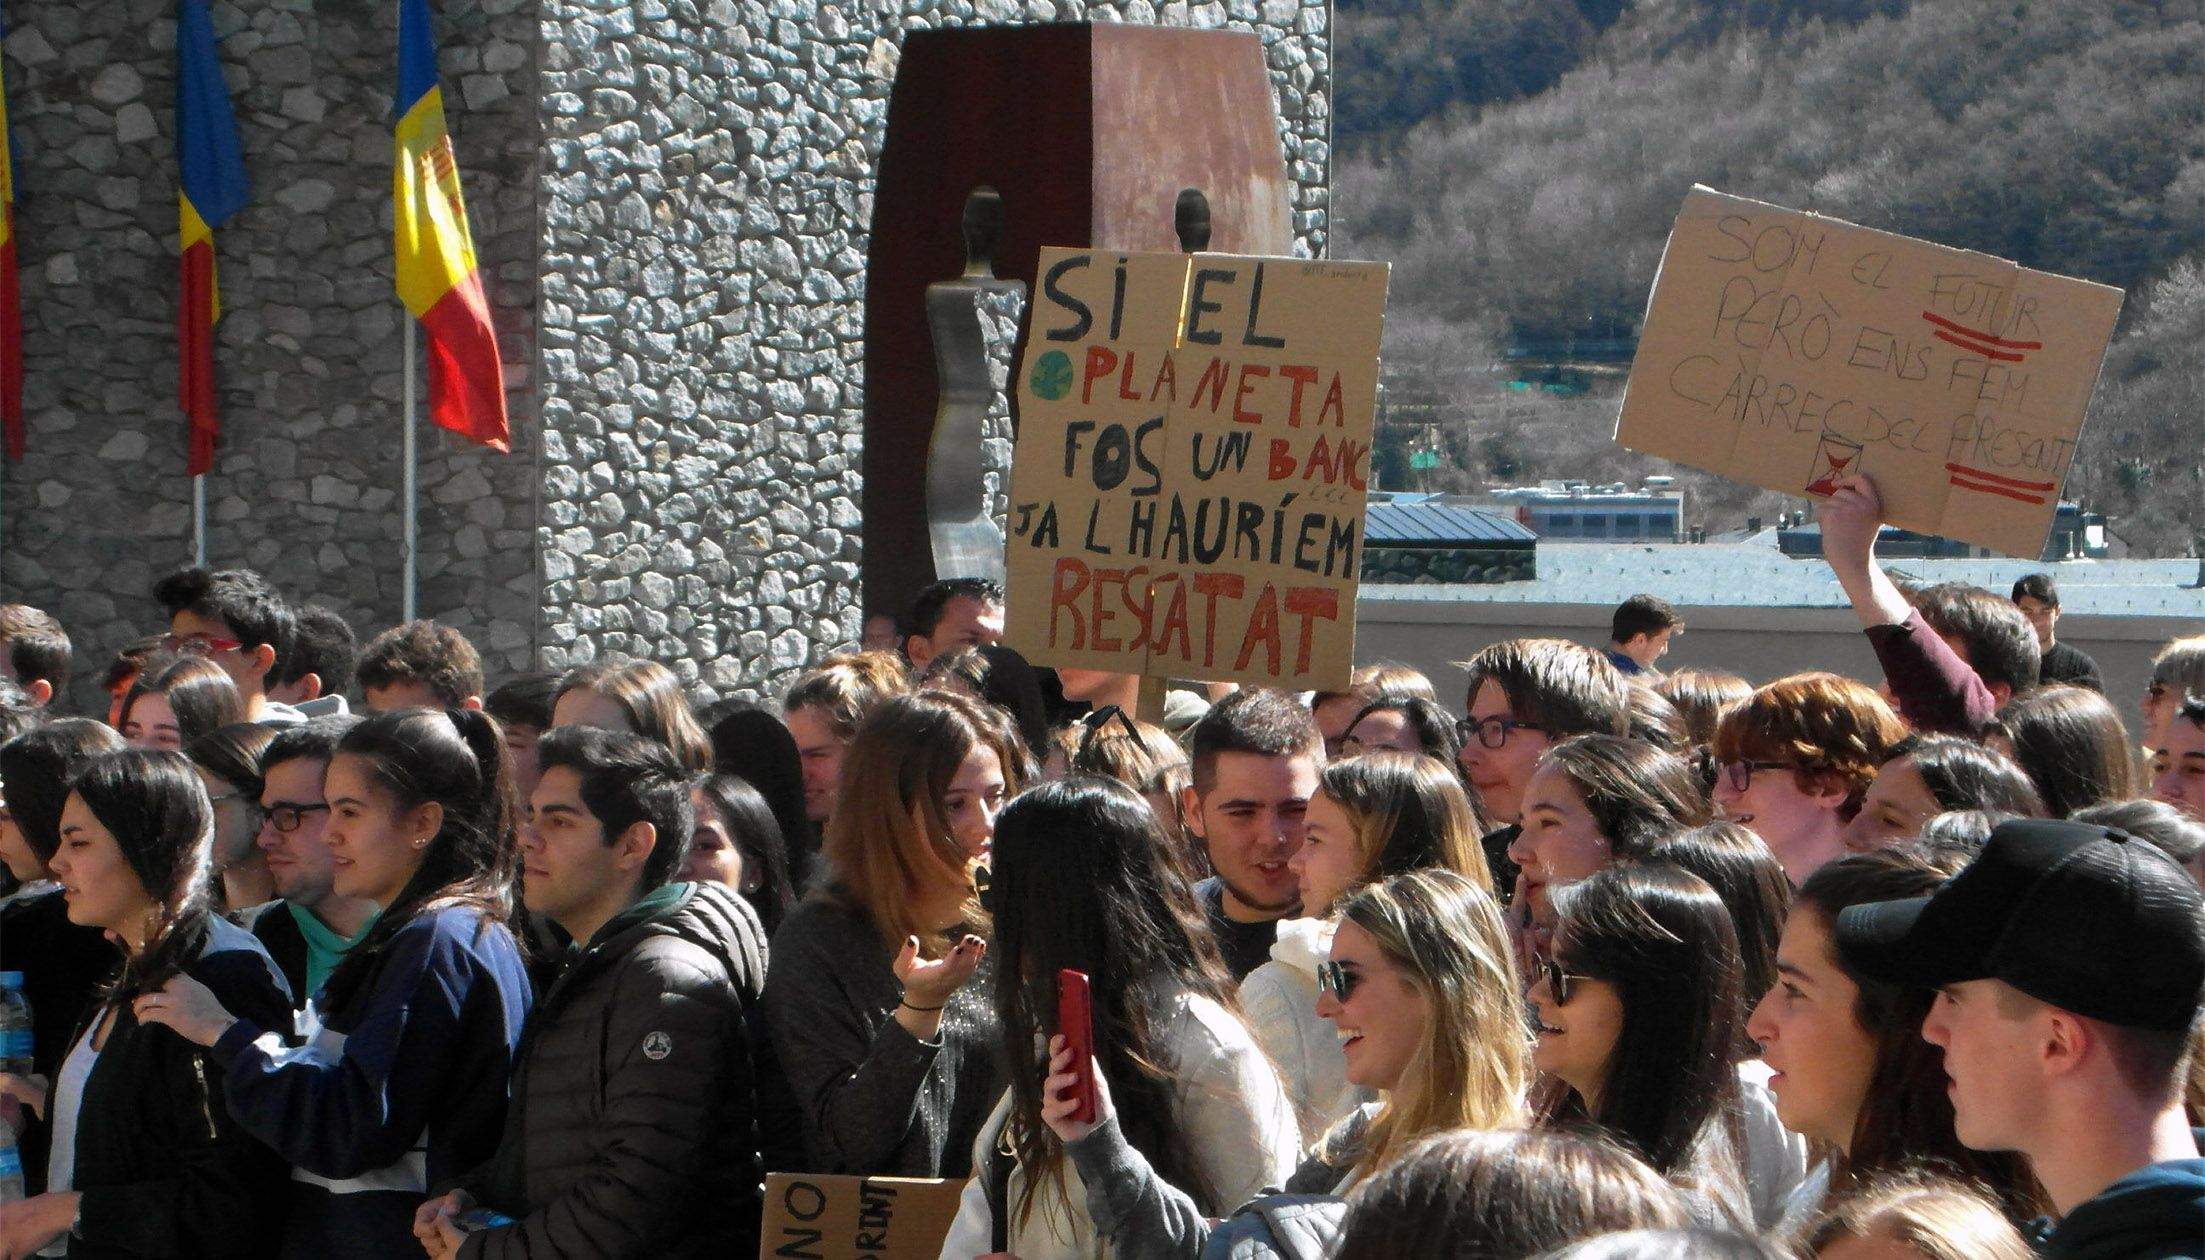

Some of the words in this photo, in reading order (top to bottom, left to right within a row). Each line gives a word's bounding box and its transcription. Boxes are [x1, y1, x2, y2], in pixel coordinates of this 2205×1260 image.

[1187, 262, 1286, 348] EL
[1707, 214, 1825, 275] SOM
[1851, 252, 1895, 290] EL
[1928, 272, 2041, 338] FUTUR
[1713, 275, 1841, 360] PERÒ
[1847, 326, 1934, 381] ENS
[1946, 356, 2031, 412] FEM
[1081, 345, 1345, 428] PLANETA
[1064, 416, 1164, 497] FOS
[1192, 430, 1252, 482] UN
[1268, 432, 1370, 491] BANC
[1014, 500, 1059, 549] JA
[775, 1181, 827, 1260] NO
